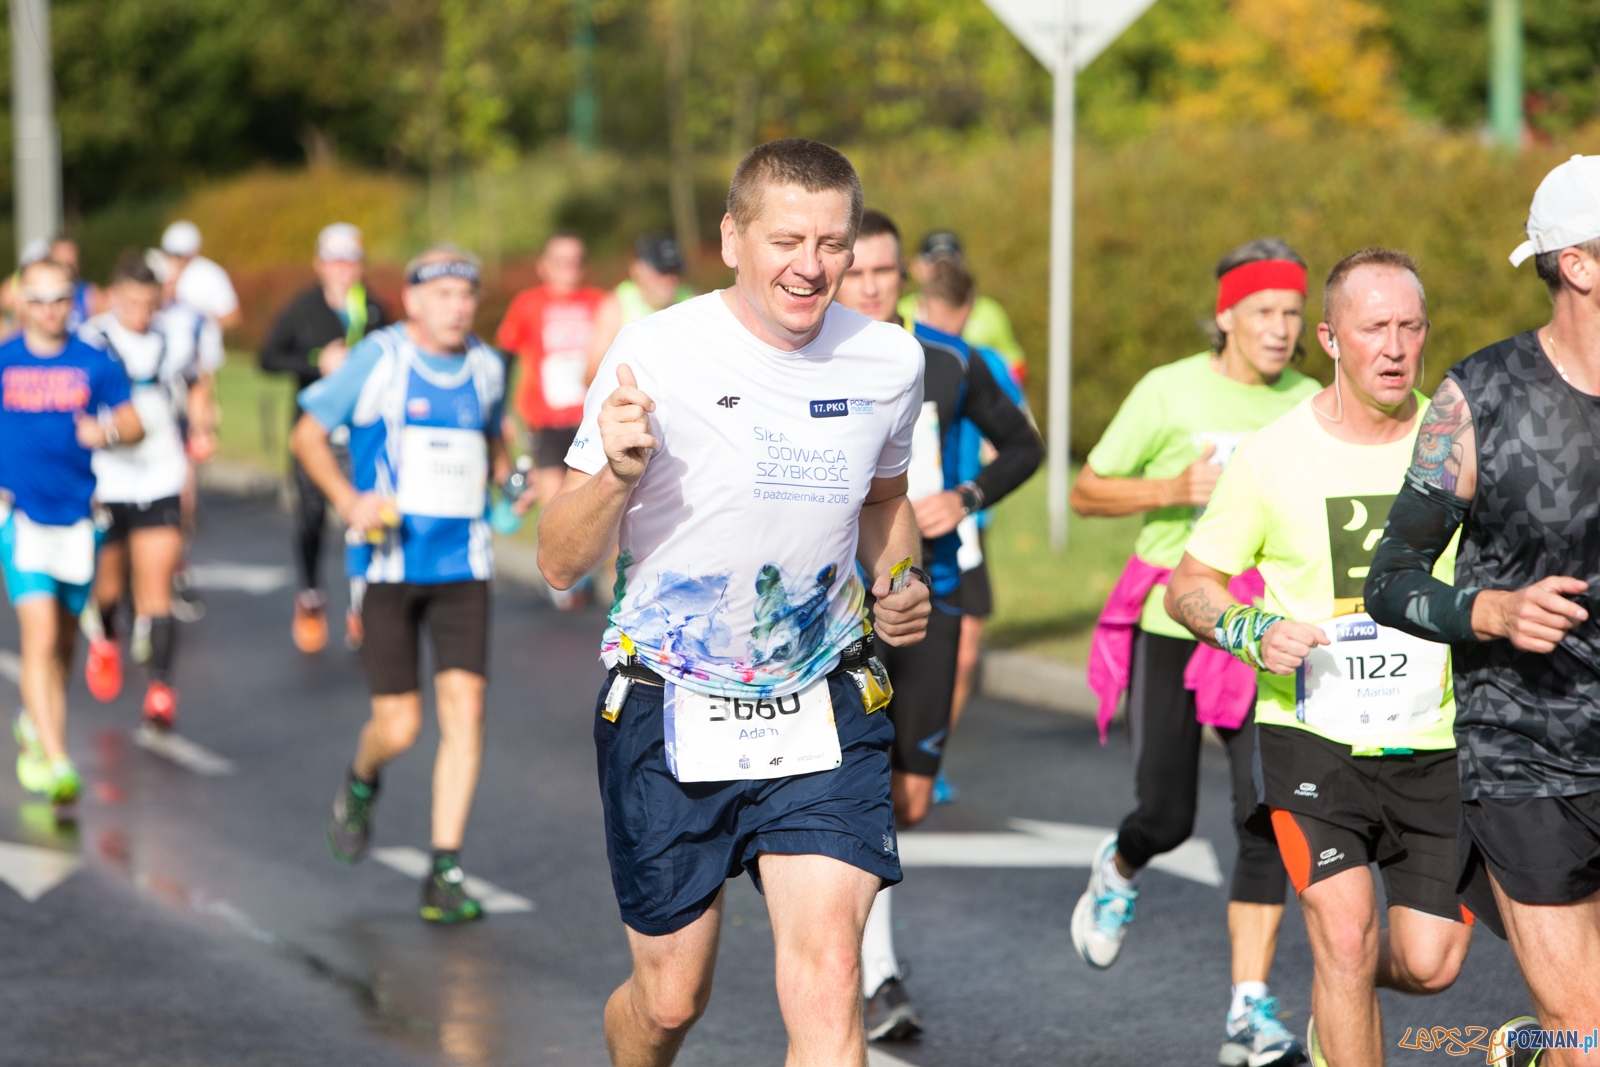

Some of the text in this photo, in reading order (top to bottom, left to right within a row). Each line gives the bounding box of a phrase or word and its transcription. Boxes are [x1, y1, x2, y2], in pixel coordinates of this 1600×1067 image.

[716, 395, 741, 408] 4F
[753, 426, 791, 444] SIŁA
[767, 445, 848, 464] ODWAGA
[756, 461, 850, 482] SZYBKOŚĆ
[753, 488, 850, 505] 9 października 2016
[1345, 653, 1408, 681] 1122
[1357, 686, 1401, 698] Marian
[739, 727, 779, 740] Adam
[769, 756, 784, 766] 4F
